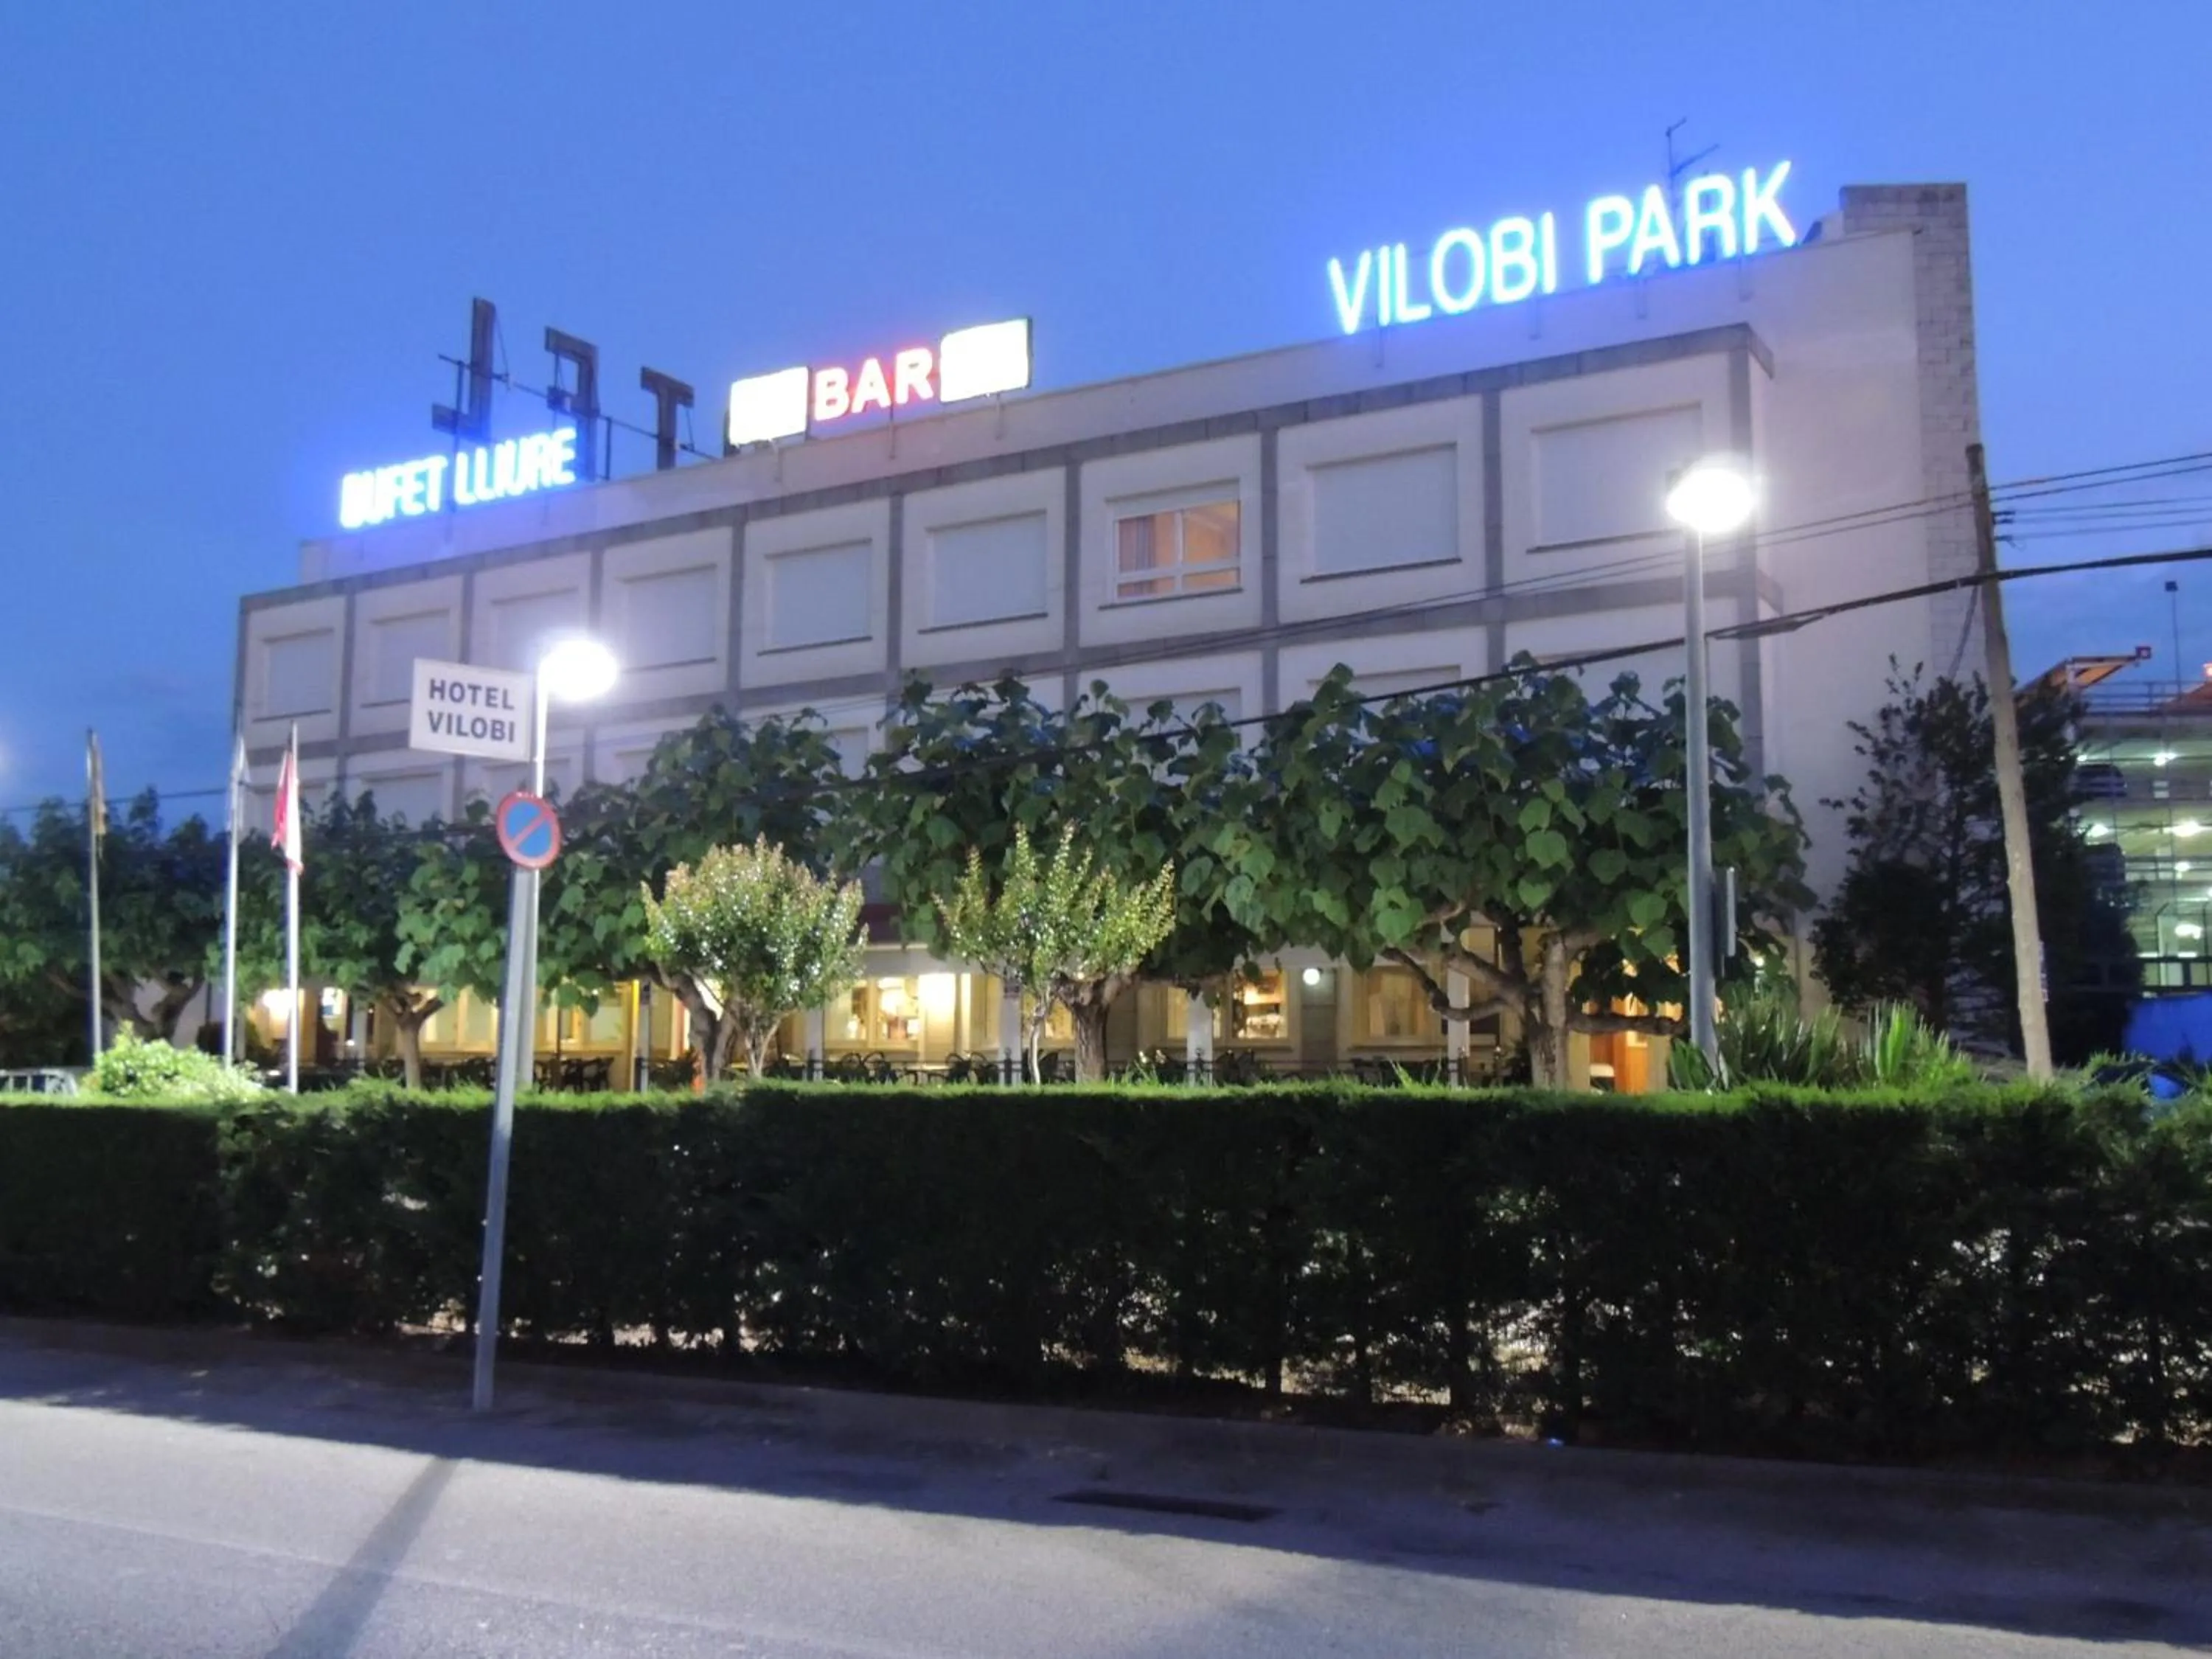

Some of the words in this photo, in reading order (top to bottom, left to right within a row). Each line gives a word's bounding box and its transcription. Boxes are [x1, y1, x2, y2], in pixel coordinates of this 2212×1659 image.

[1329, 212, 1556, 336] VILOBI
[1587, 161, 1797, 285] PARK
[814, 347, 933, 421] BAR
[454, 428, 577, 505] LLIURE
[428, 678, 515, 710] HOTEL
[428, 710, 515, 742] VILOBI
